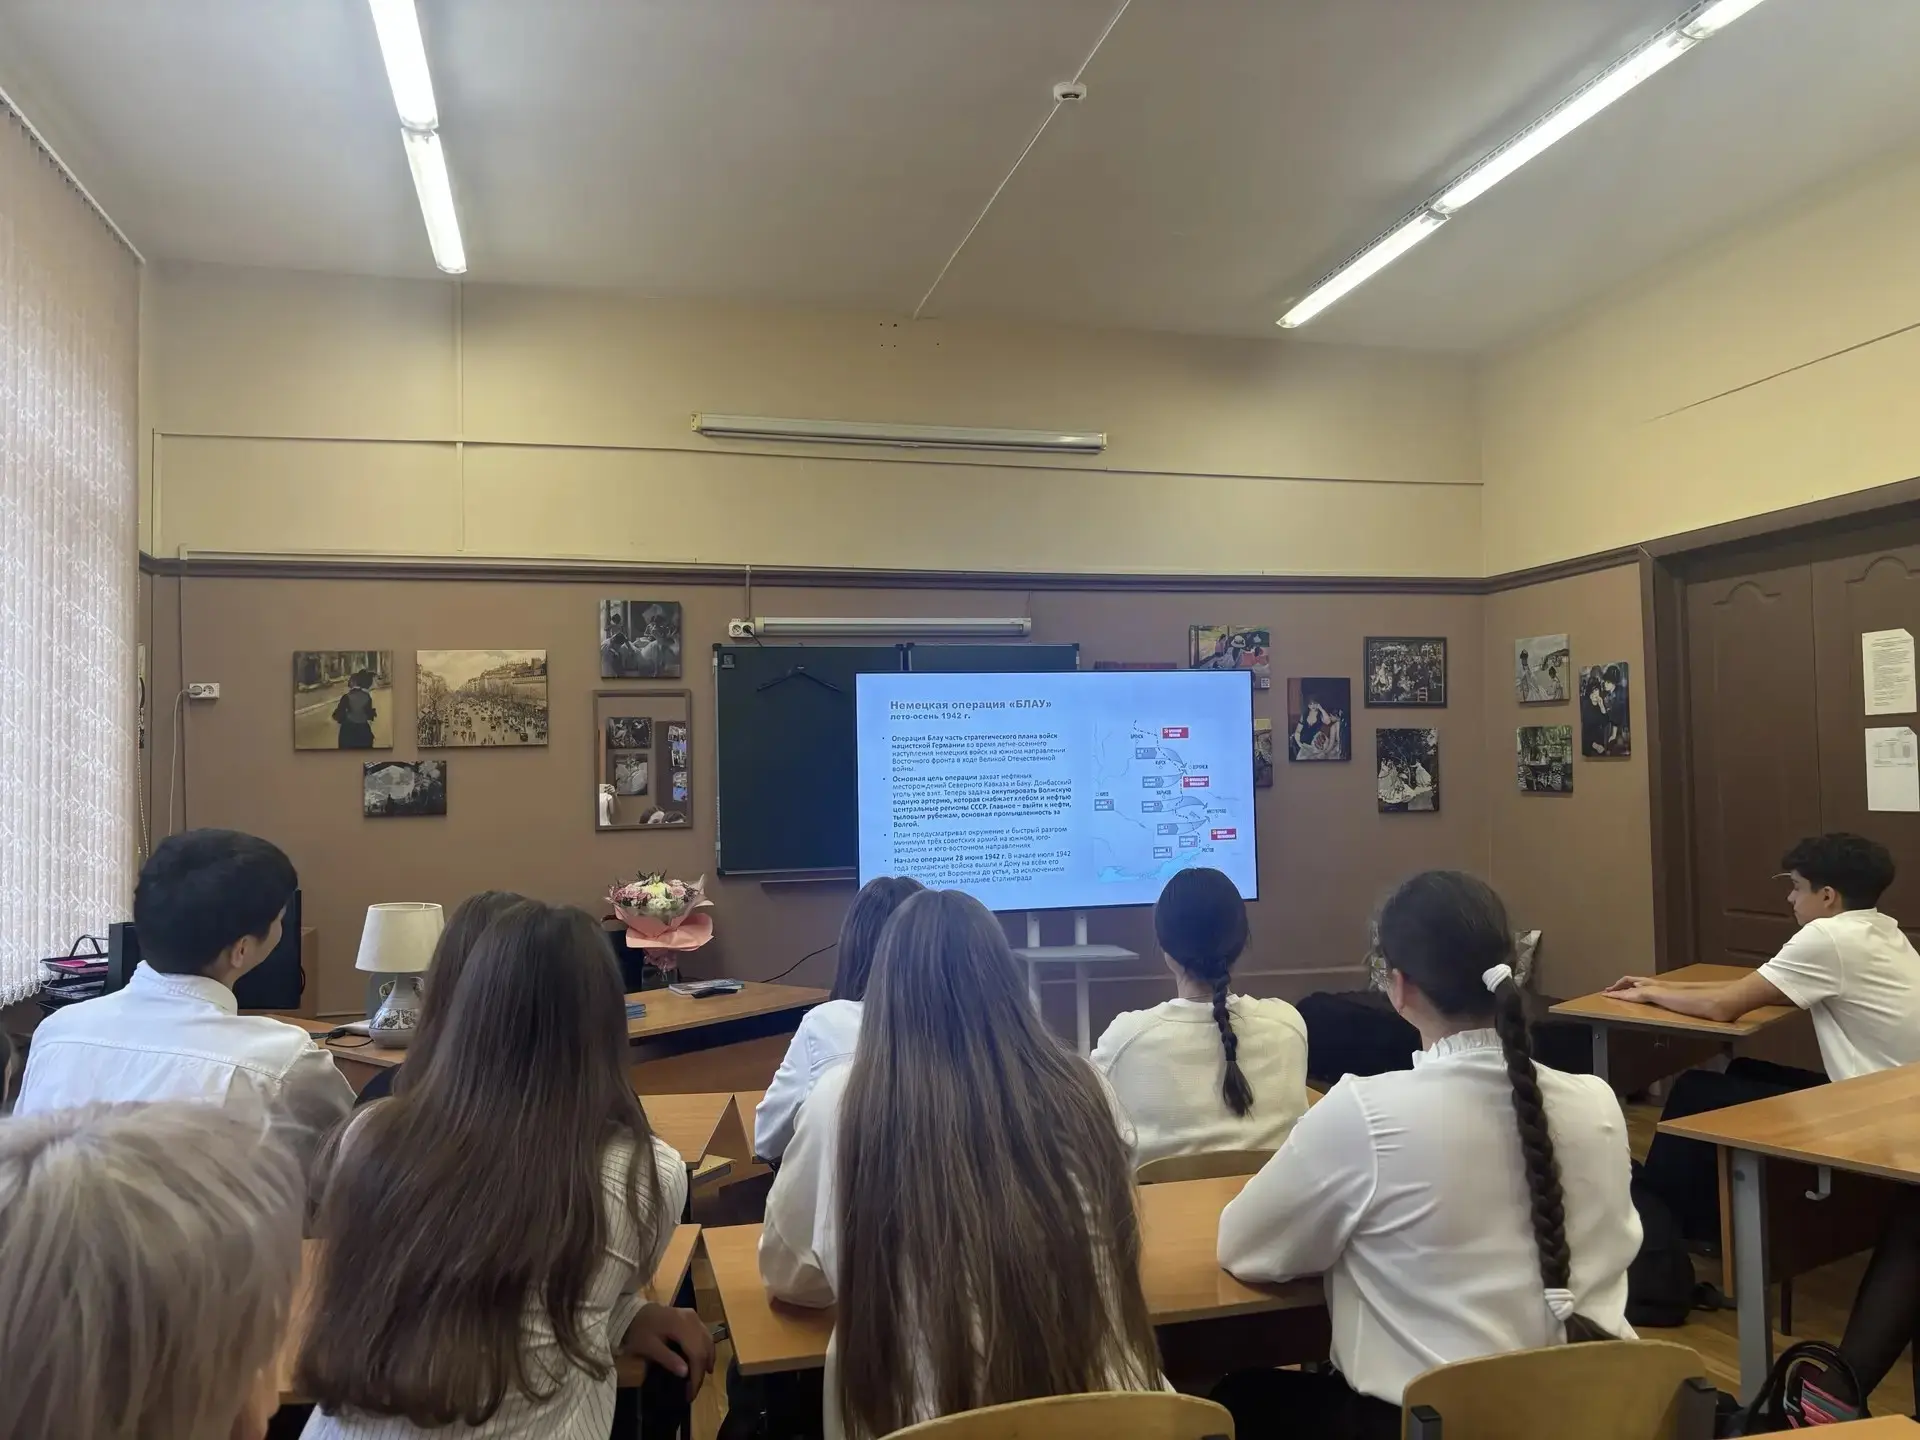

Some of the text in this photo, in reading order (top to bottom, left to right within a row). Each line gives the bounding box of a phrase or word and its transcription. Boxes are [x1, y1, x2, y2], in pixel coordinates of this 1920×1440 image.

[890, 700, 1052, 710] Немецкая операция «БЛАУ»
[944, 789, 967, 797] Теперь
[981, 795, 1014, 803] снабжает
[892, 805, 939, 813] центральные
[993, 810, 1052, 818] промышленность
[893, 820, 920, 828] Волгой.
